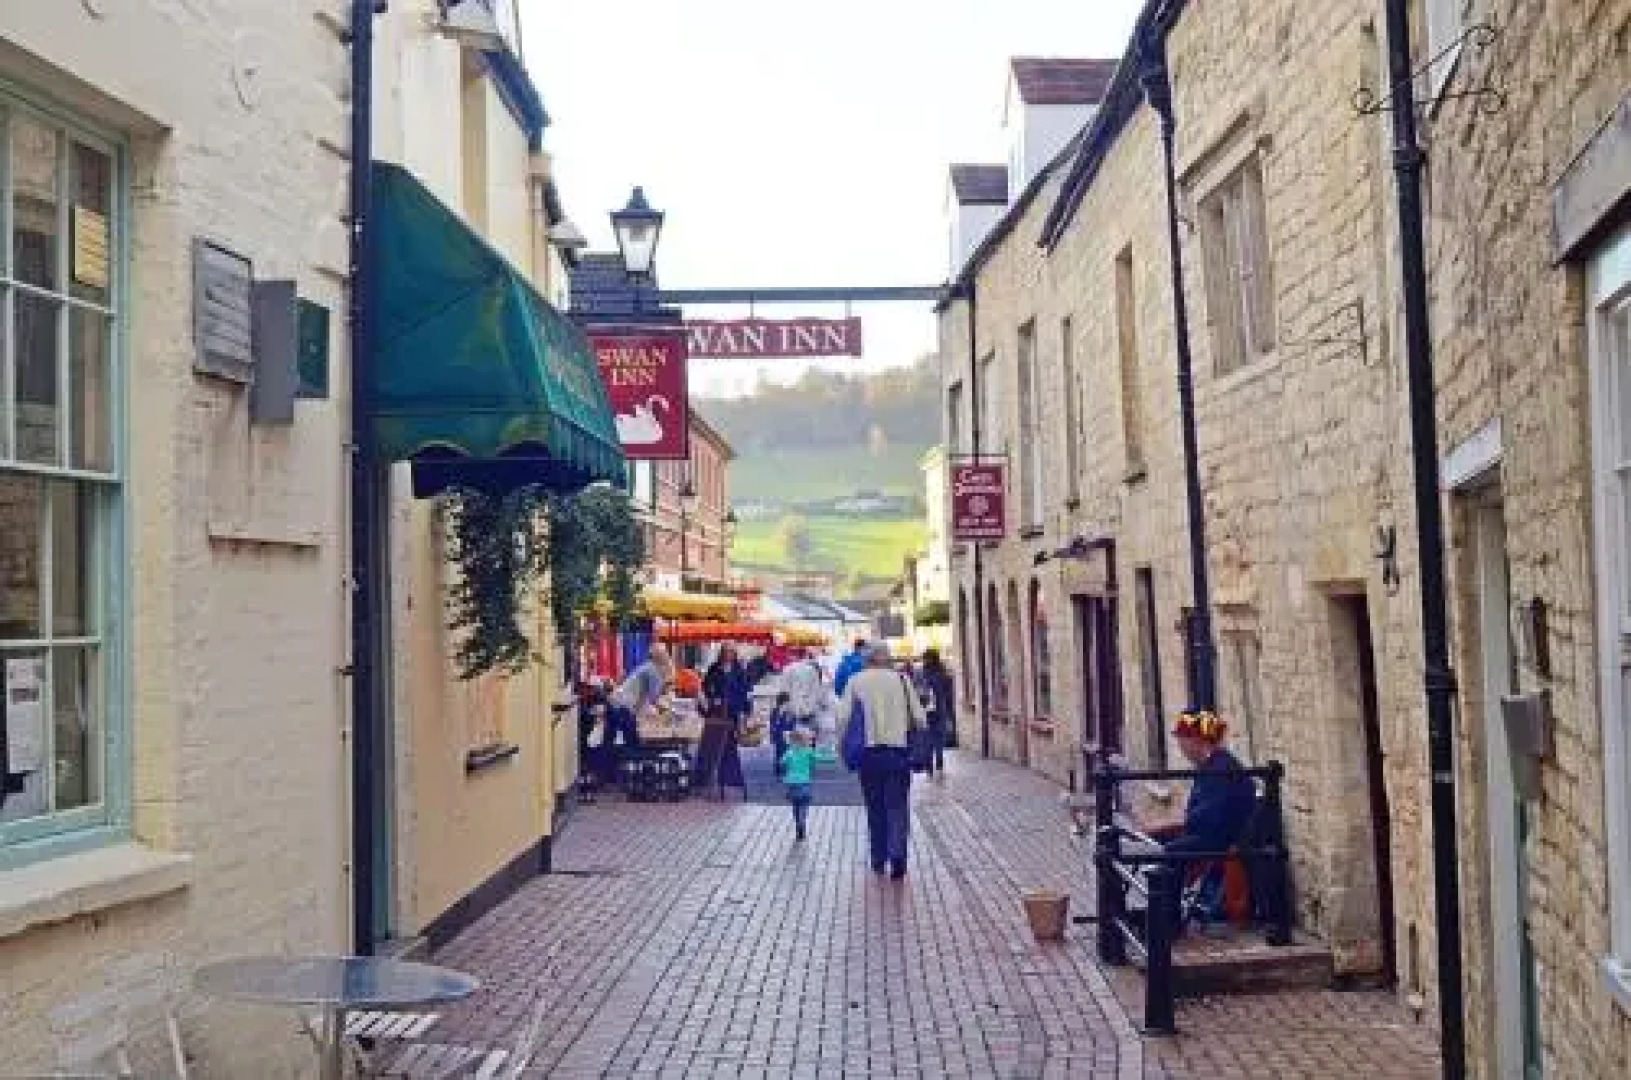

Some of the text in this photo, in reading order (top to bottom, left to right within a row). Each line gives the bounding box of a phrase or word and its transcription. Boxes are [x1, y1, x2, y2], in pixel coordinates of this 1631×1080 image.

[686, 325, 848, 352] WAN INN
[597, 347, 667, 366] SWAN
[611, 368, 656, 386] INN
